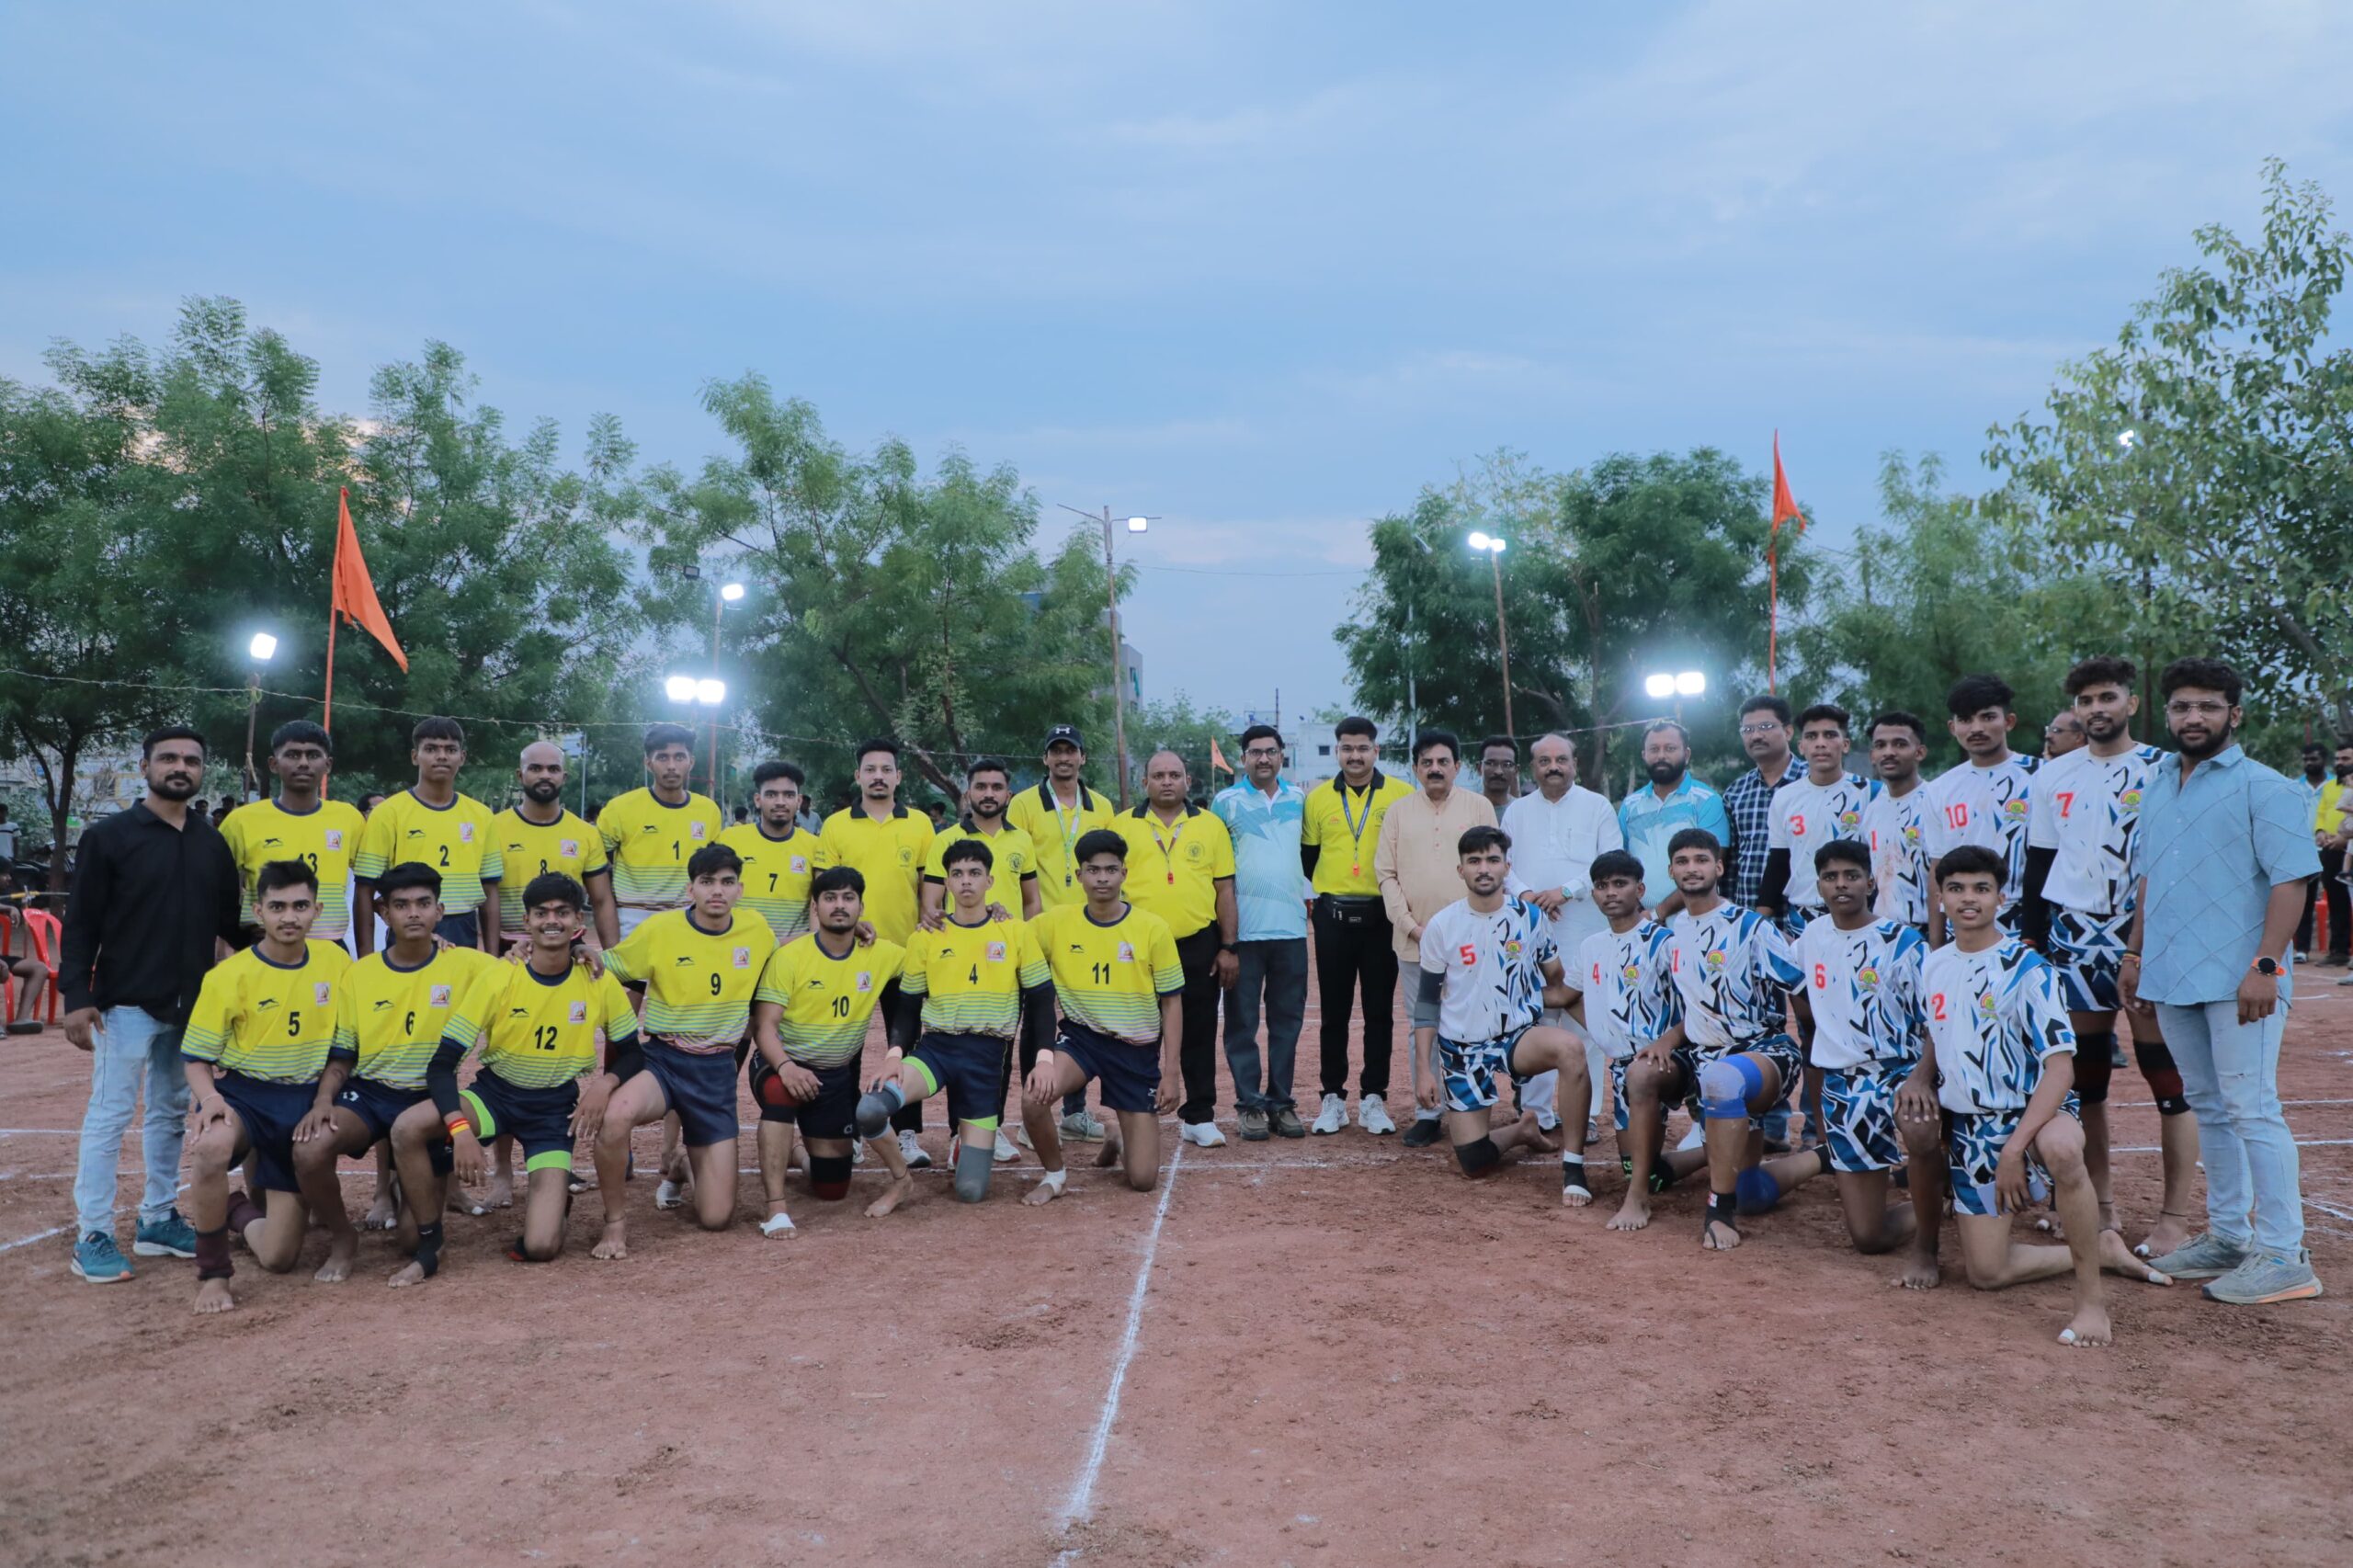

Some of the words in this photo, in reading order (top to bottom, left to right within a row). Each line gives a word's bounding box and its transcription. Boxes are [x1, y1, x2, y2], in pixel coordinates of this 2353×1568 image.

[1945, 802, 1969, 830] 10
[2056, 791, 2075, 818] 7
[1790, 814, 1806, 835] 3
[439, 845, 450, 867] 2
[672, 840, 679, 860] 1
[539, 858, 549, 876] 8
[768, 872, 779, 892] 7
[1460, 943, 1477, 966] 5
[710, 972, 722, 996] 9
[969, 963, 978, 985] 4
[1092, 962, 1109, 985] 11
[1593, 963, 1601, 985] 4
[1814, 963, 1827, 990] 6
[831, 995, 850, 1018] 10
[1930, 993, 1948, 1021] 2
[288, 1011, 301, 1037] 5
[404, 1011, 415, 1036] 6
[534, 1025, 558, 1051] 12
